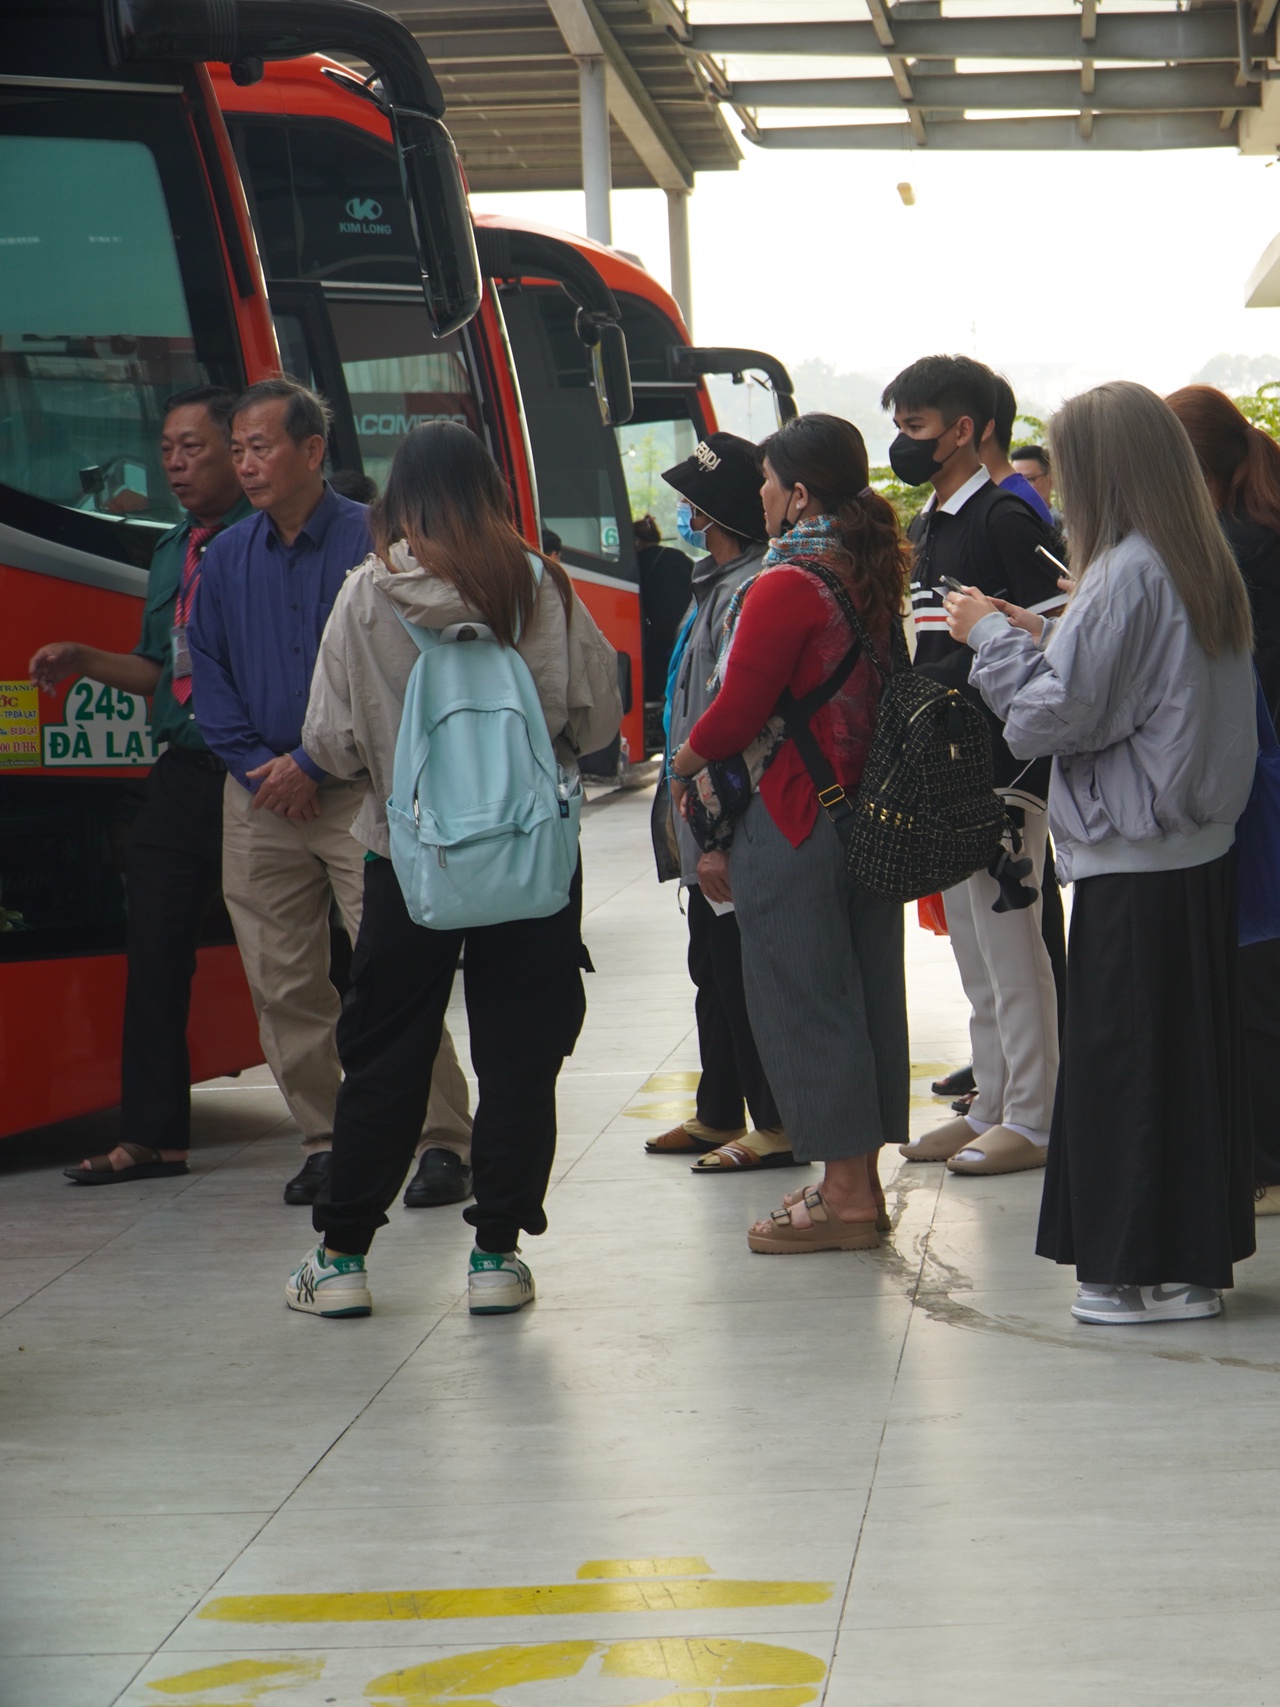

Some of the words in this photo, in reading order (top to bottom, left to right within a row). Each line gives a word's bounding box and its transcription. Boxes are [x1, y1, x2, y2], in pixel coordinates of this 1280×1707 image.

[340, 222, 361, 233] KIM
[362, 224, 392, 235] LONG
[75, 683, 135, 721] 245
[49, 724, 93, 759] ĐÀ
